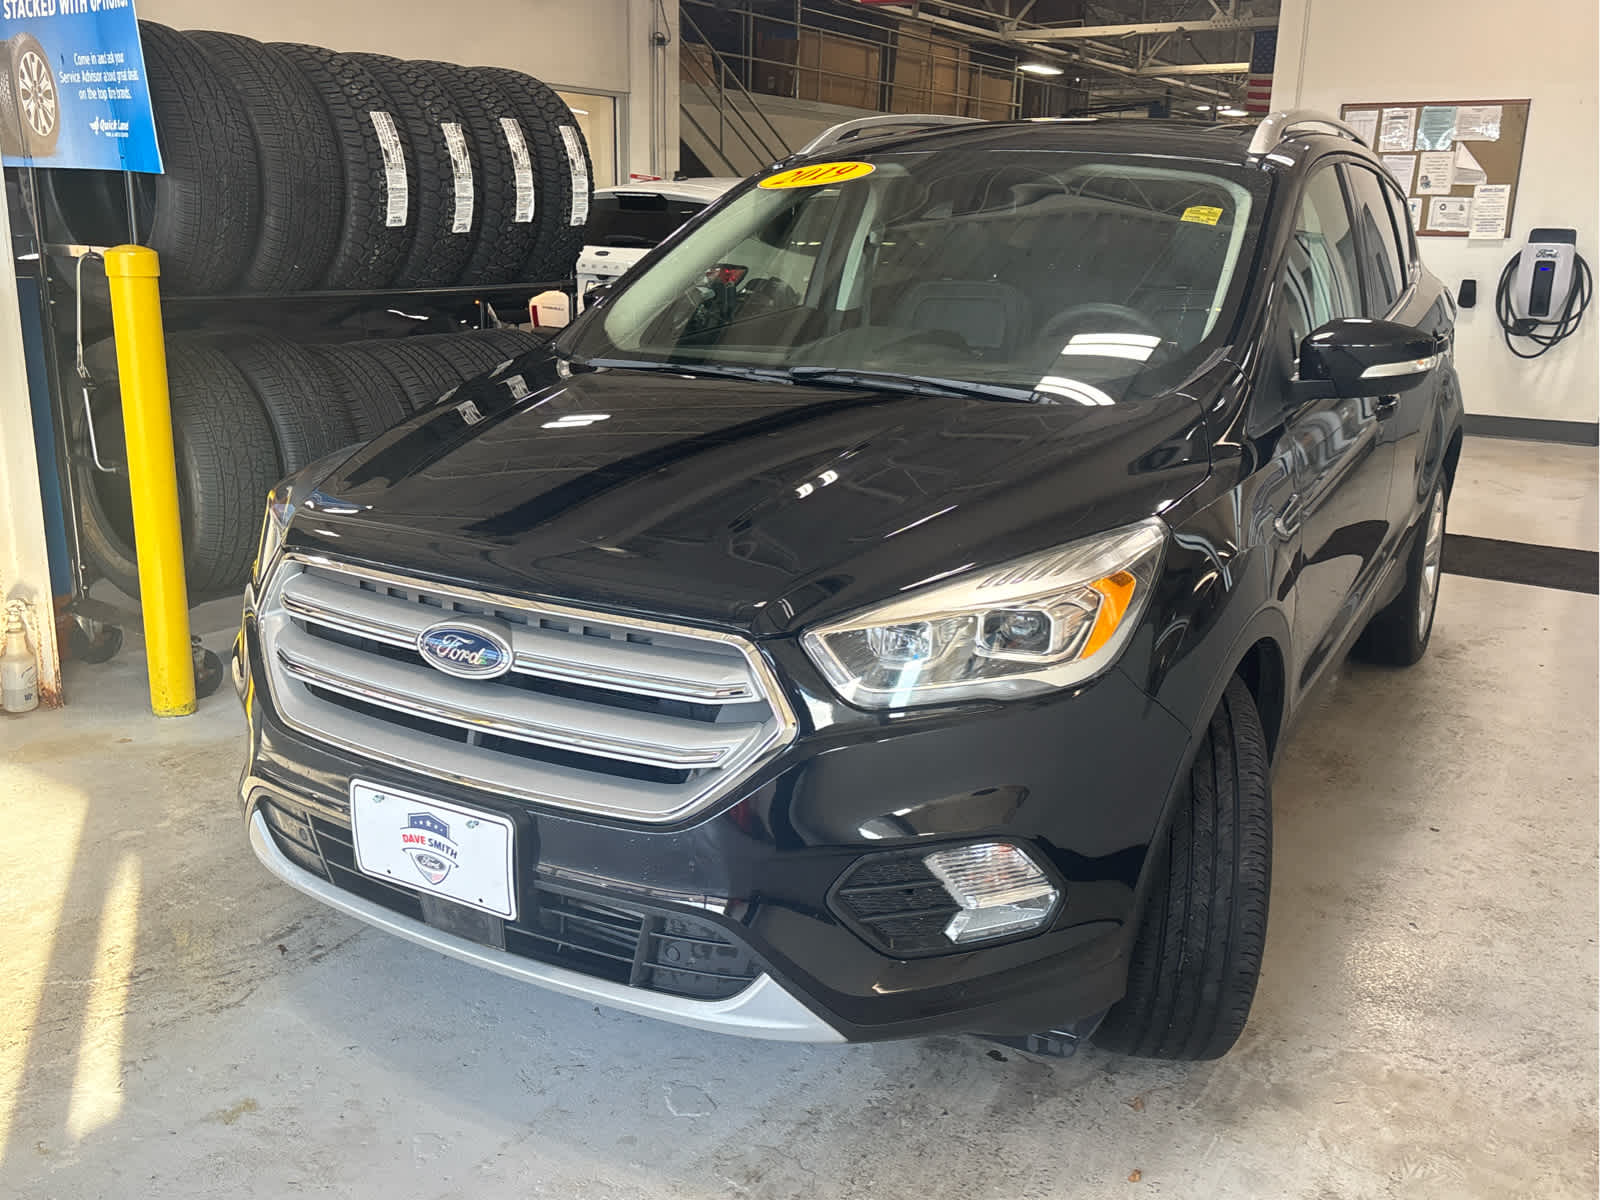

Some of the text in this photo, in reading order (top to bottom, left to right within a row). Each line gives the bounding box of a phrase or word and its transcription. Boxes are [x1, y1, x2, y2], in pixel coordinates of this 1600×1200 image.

[4, 0, 56, 19] STACKED
[59, 0, 88, 15] WITH
[73, 52, 90, 65] Come
[90, 51, 97, 65] in
[59, 70, 80, 83] Service
[81, 70, 102, 82] Advisor
[79, 89, 86, 99] on
[86, 87, 97, 99] the
[97, 87, 107, 101] top
[100, 119, 129, 132] Quick Lane
[770, 164, 860, 185] 2019
[1536, 248, 1559, 258] Ford
[437, 634, 488, 665] Ford
[402, 833, 458, 859] DAVE SMITH
